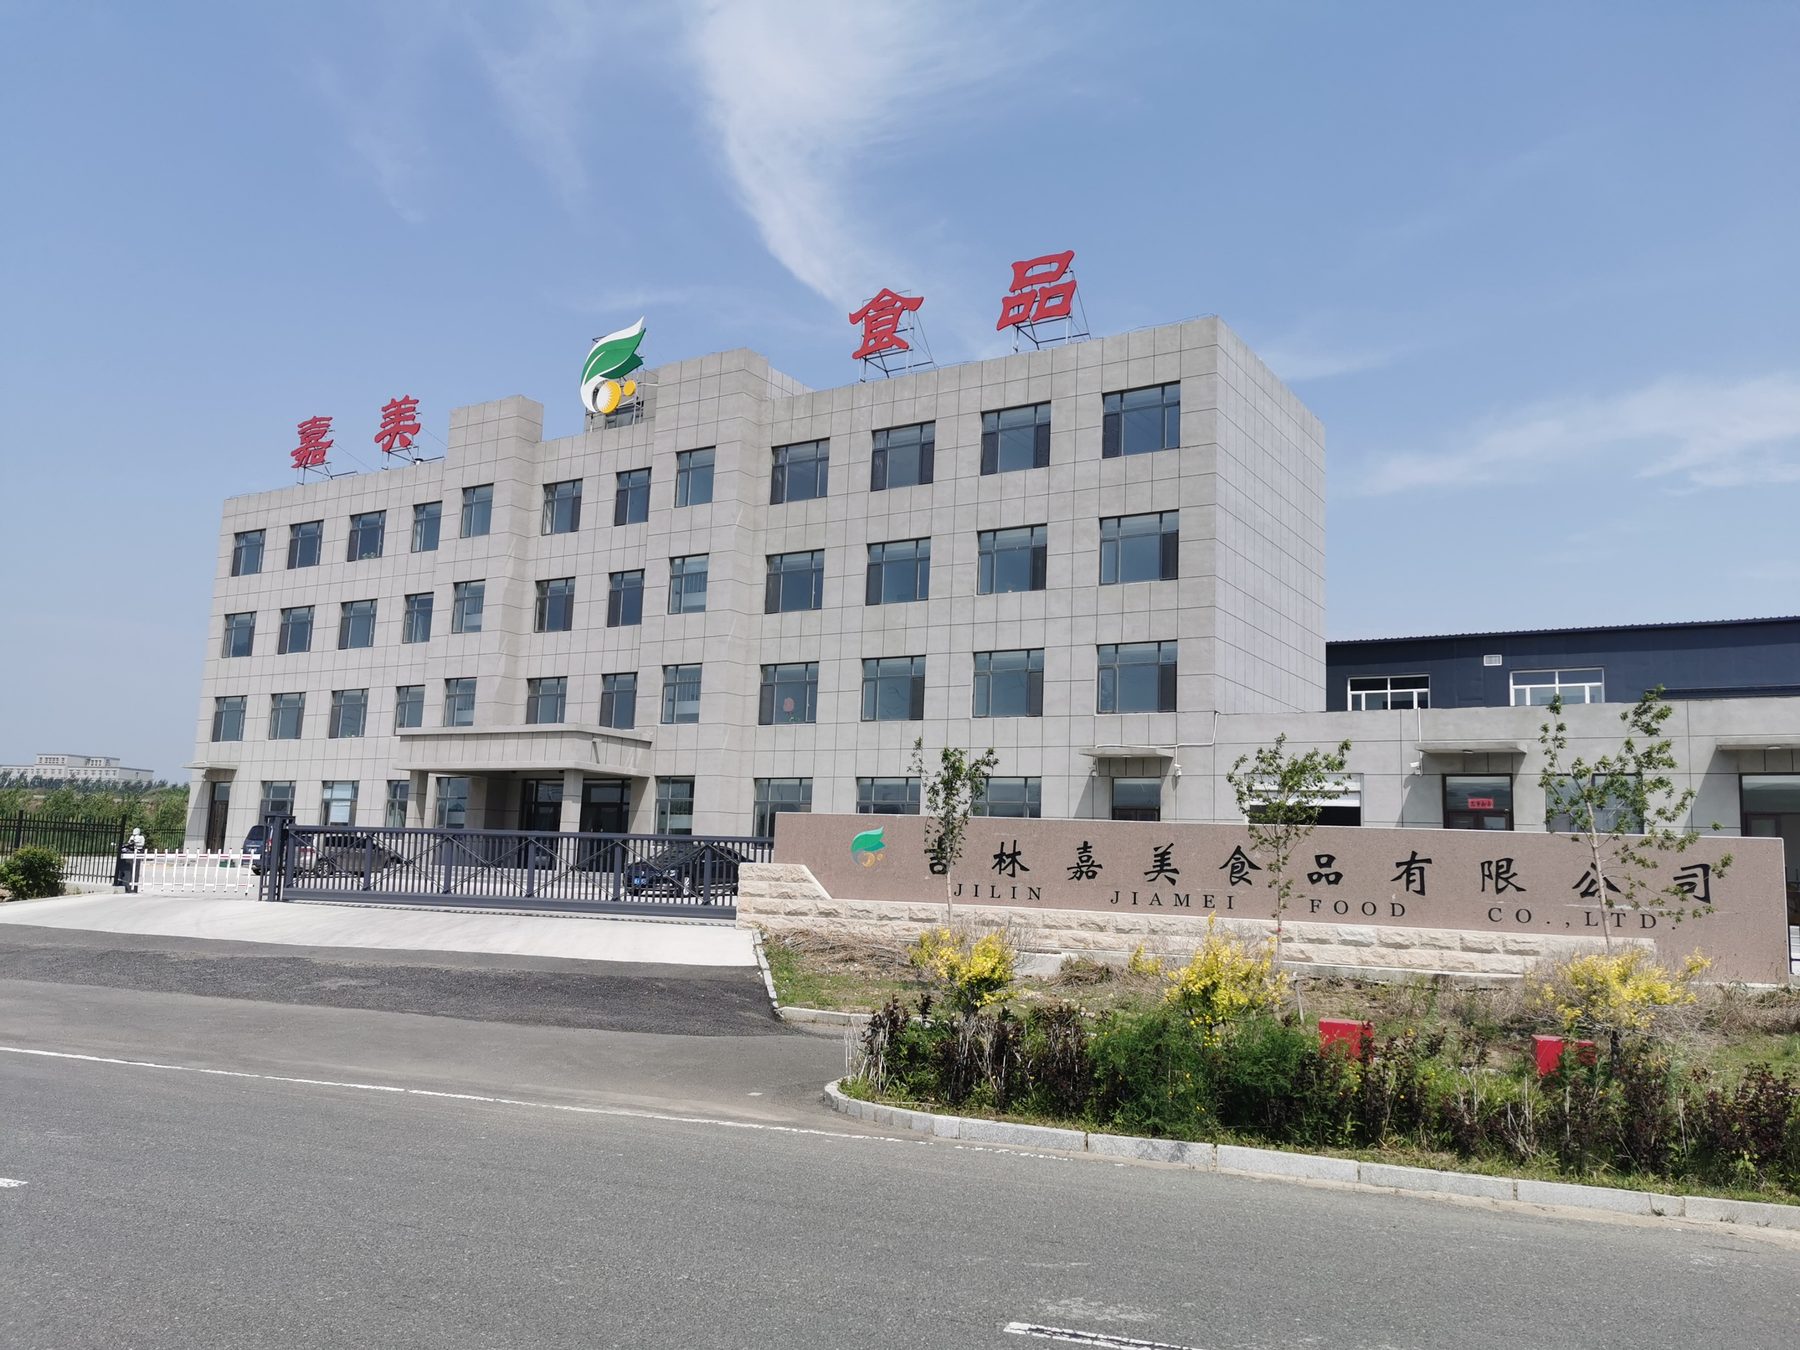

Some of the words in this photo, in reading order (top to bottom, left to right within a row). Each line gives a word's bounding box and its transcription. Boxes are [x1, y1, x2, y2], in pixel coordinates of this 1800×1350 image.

[290, 395, 421, 468] 嘉美
[849, 250, 1076, 360] 食品
[953, 883, 1042, 900] JILIN
[1110, 890, 1235, 910] JIAMEI
[1309, 899, 1406, 918] FOOD
